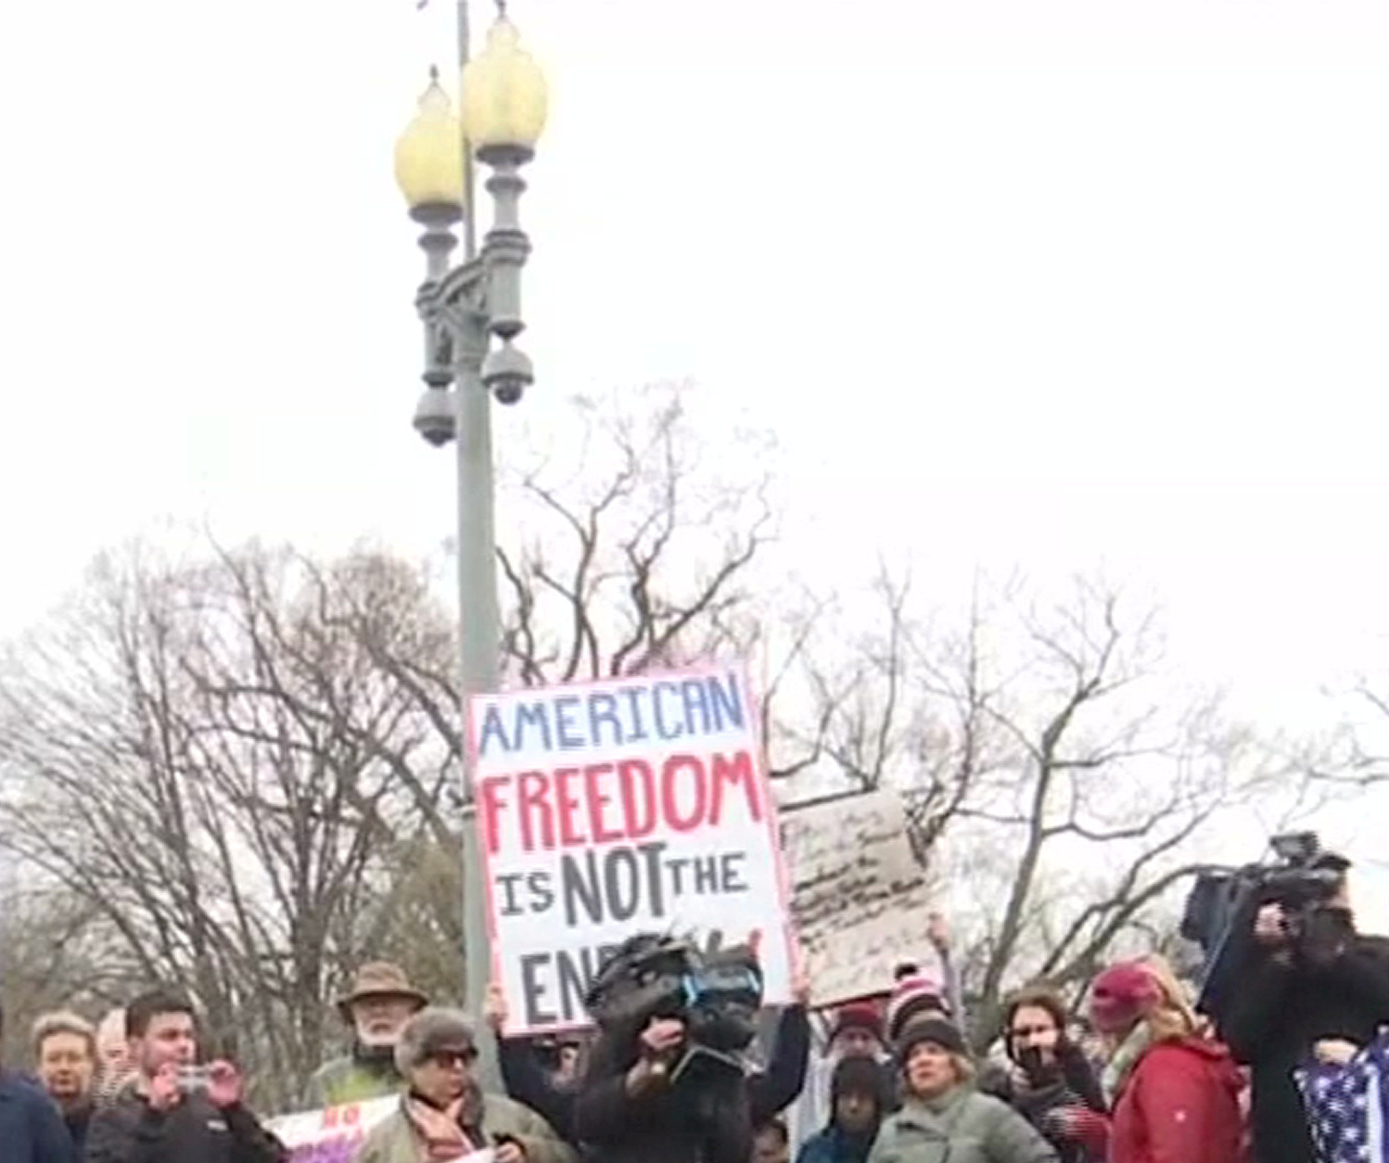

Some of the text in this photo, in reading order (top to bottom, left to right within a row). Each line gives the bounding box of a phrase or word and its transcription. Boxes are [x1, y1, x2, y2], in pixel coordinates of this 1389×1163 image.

[480, 673, 744, 755] AMERICAN
[481, 751, 761, 853] FREEDOM
[497, 871, 554, 916] IS
[561, 841, 666, 927] NOT
[665, 854, 748, 896] THE
